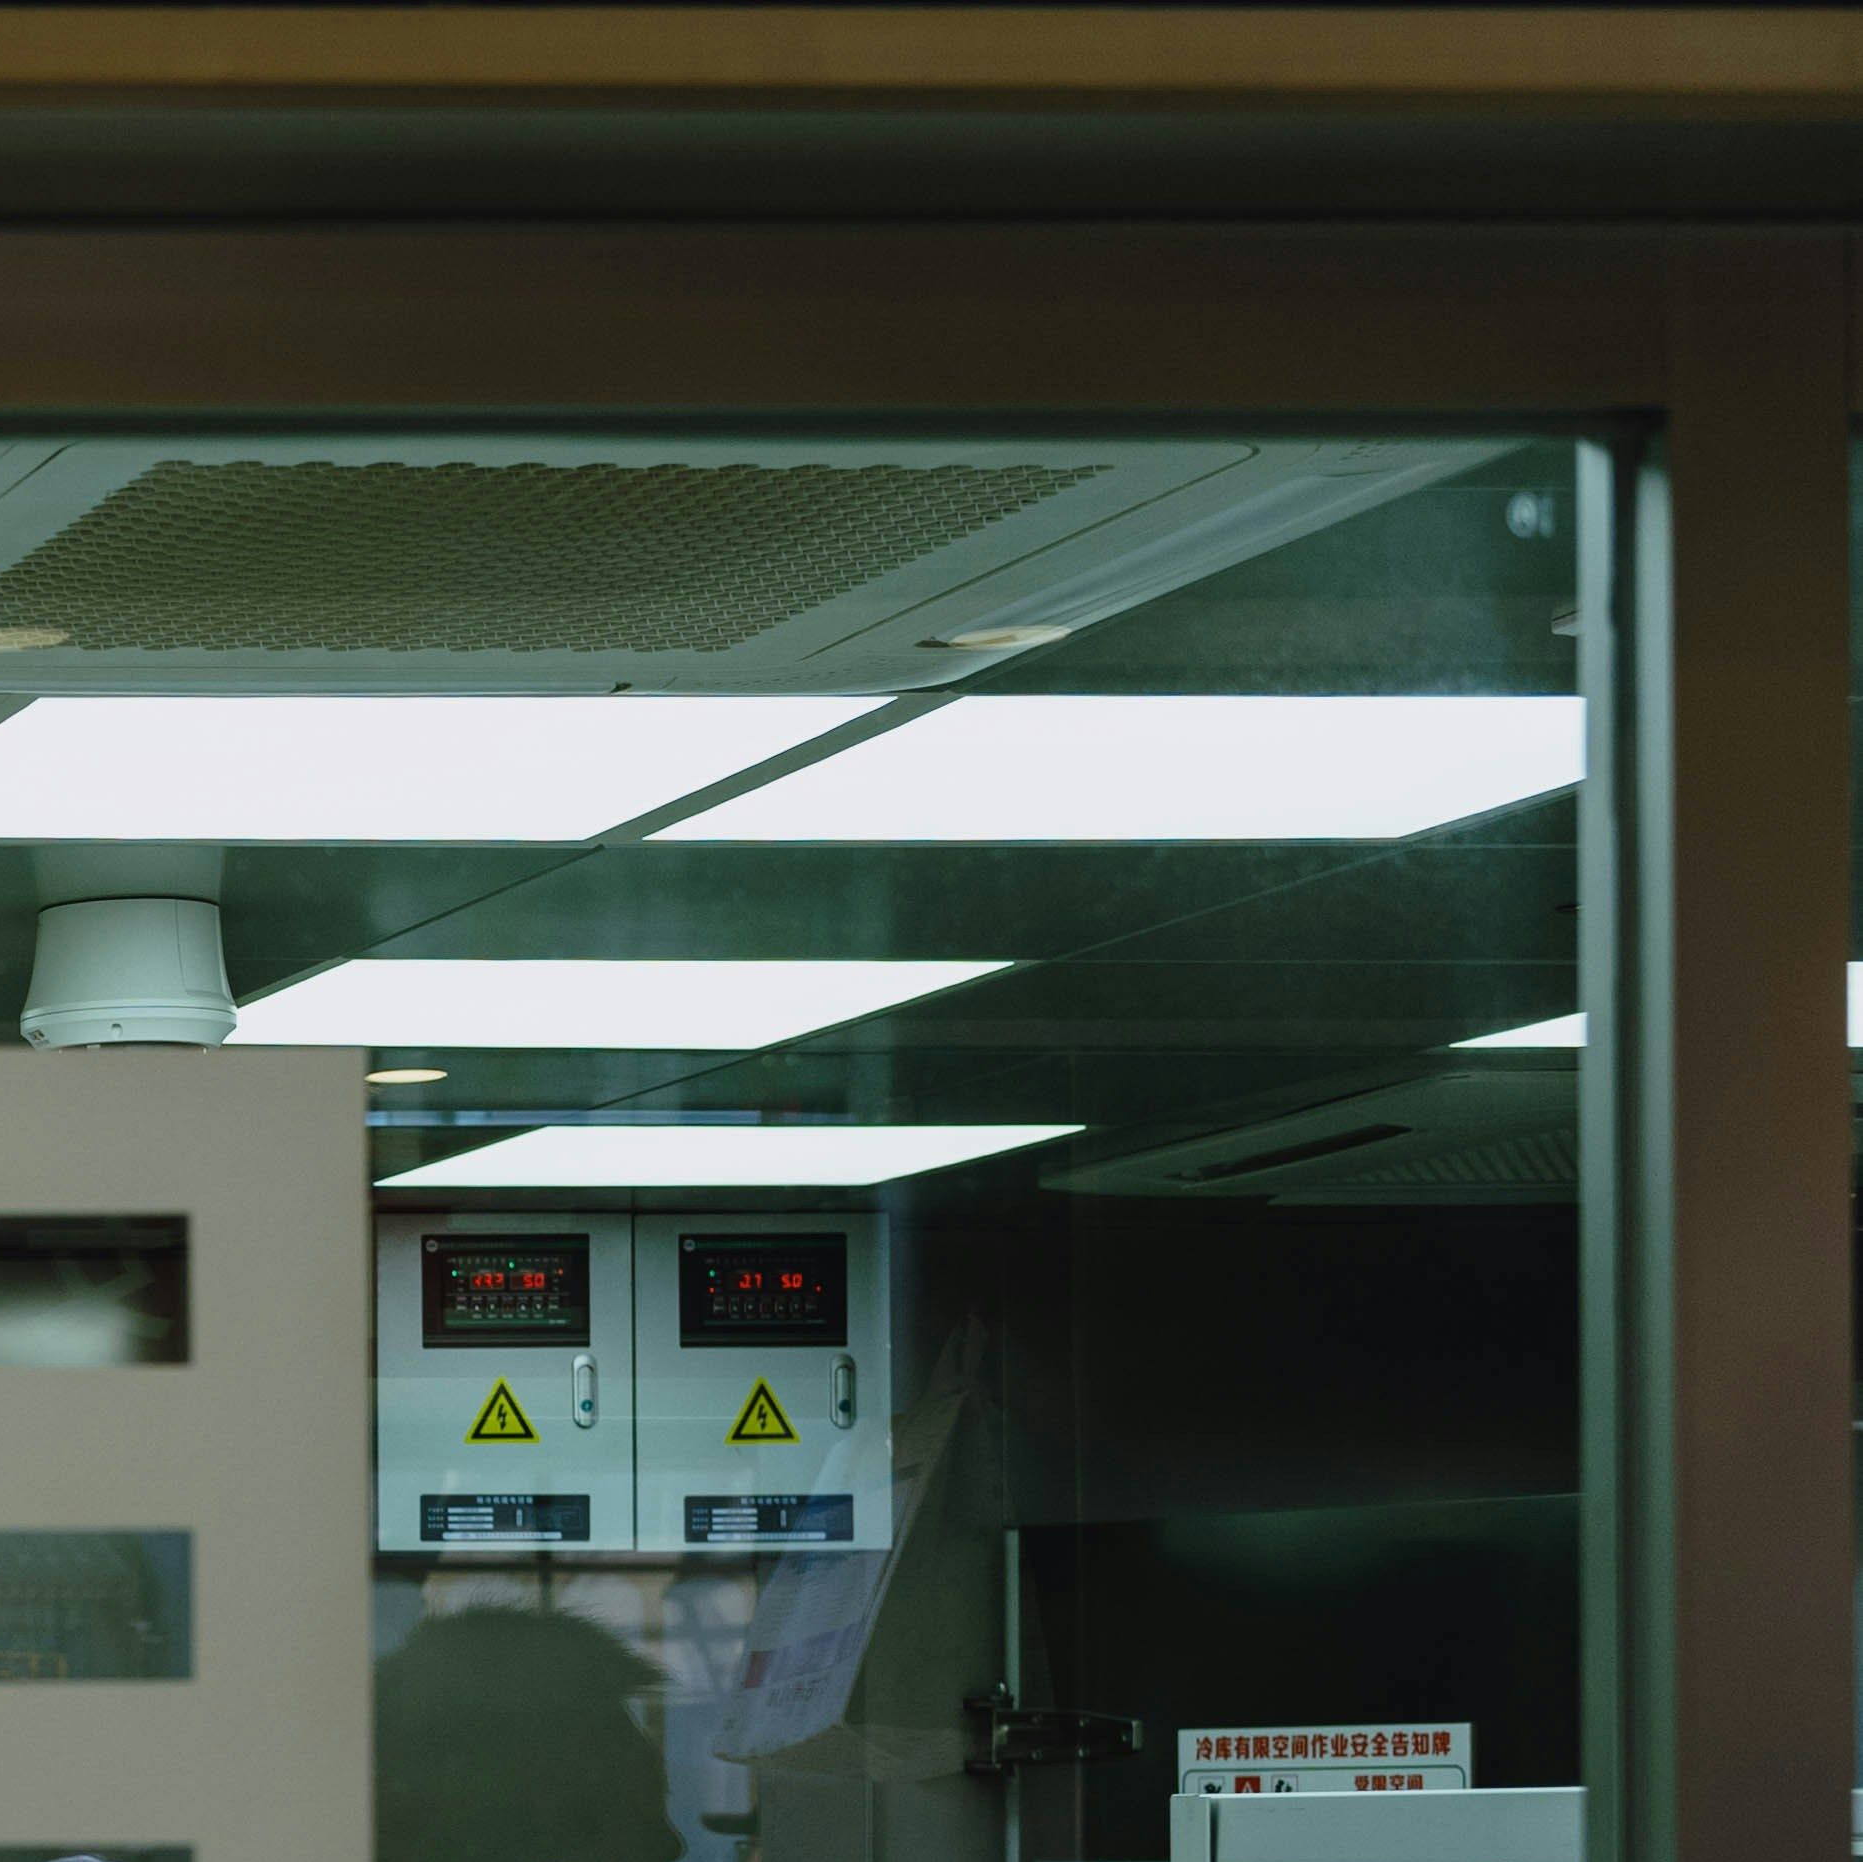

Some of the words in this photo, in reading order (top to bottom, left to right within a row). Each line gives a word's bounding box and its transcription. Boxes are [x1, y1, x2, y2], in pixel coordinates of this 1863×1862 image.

[1195, 1731, 1452, 1761] 冷库有限空间作业安全告知牌
